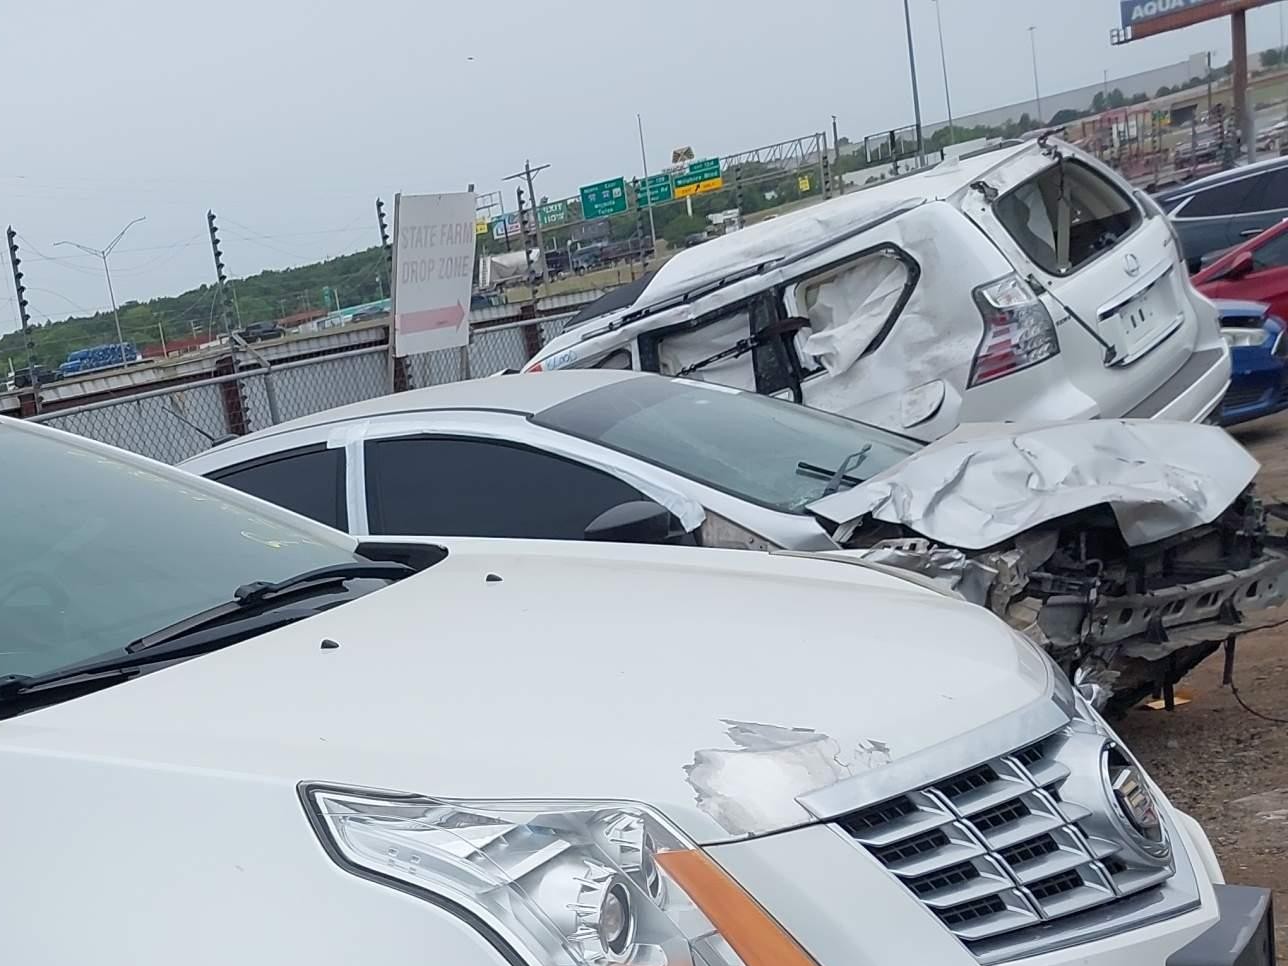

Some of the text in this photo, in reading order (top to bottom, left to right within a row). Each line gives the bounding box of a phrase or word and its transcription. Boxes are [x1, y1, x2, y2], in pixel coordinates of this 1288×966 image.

[1131, 0, 1185, 20] AQUA
[401, 225, 437, 249] STATE
[439, 221, 473, 246] FARM
[402, 255, 469, 284] DROP ZONE
